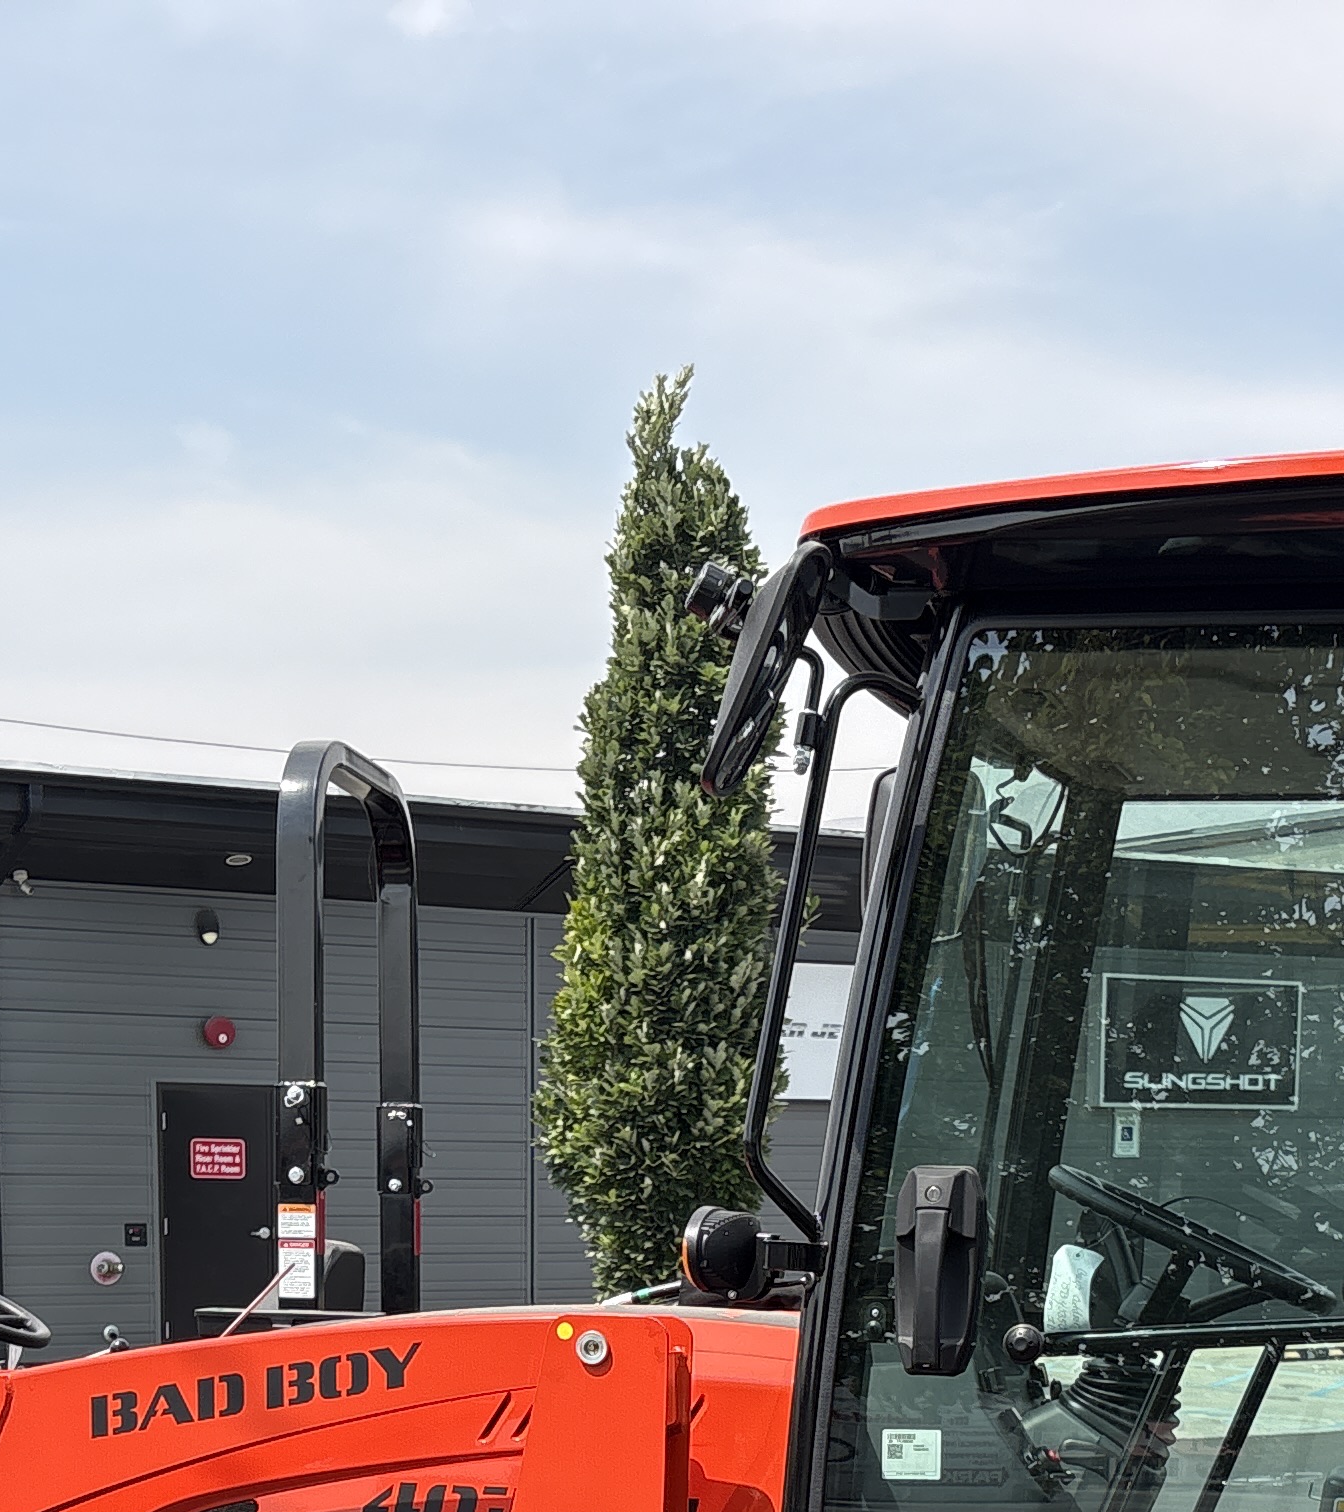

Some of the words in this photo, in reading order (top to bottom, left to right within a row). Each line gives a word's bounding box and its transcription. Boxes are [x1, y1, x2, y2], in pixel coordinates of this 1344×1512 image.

[1123, 1071, 1283, 1092] SLINGSHOT
[90, 1372, 245, 1439] BAD
[266, 1341, 422, 1411] BOY
